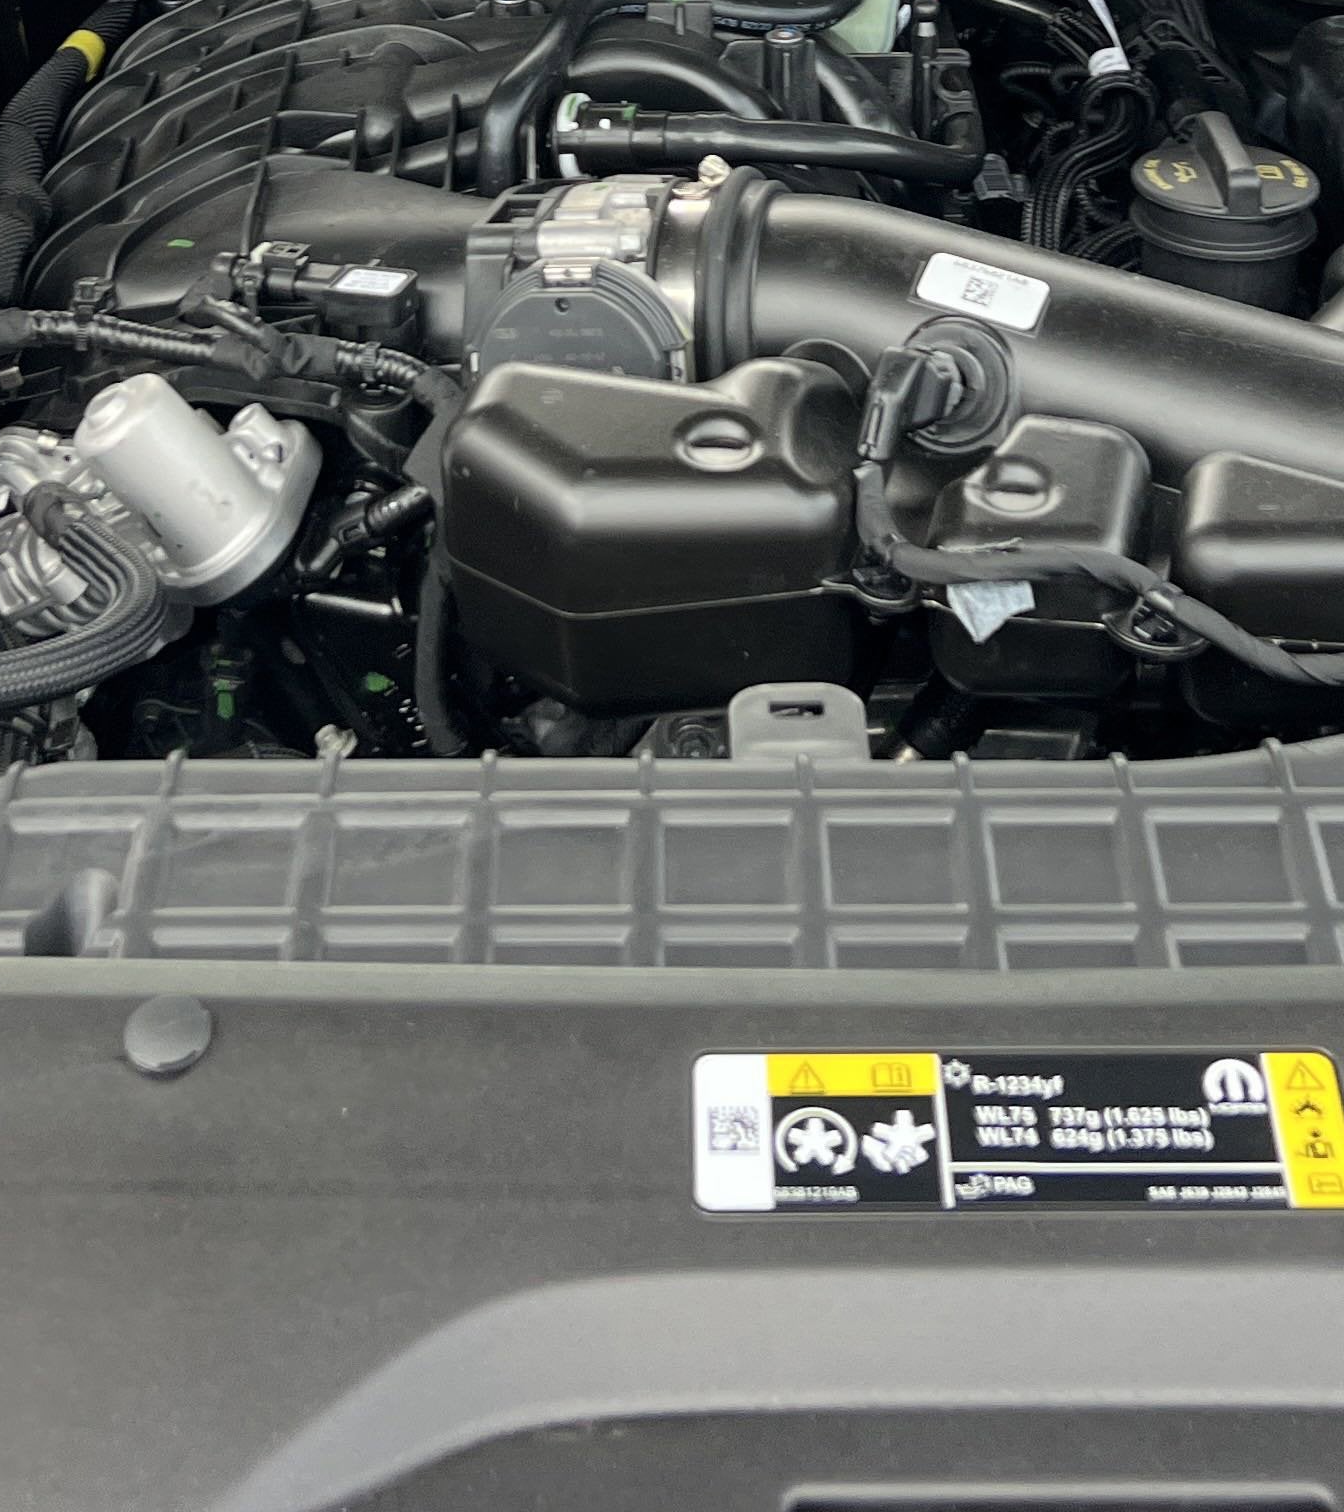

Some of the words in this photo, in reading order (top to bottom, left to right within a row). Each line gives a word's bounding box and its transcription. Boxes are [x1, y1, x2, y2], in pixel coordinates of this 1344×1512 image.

[971, 1074, 1065, 1100] R-1234yf
[973, 1105, 1038, 1126] WL75
[1048, 1106, 1102, 1130] 737g
[1103, 1106, 1166, 1128] (1.625
[1167, 1106, 1211, 1128] lbs)
[976, 1126, 1040, 1148] WL74
[1050, 1127, 1105, 1153] 624g
[1106, 1127, 1170, 1151] (1.375
[1171, 1127, 1215, 1152] lbs)
[993, 1175, 1036, 1197] PAG
